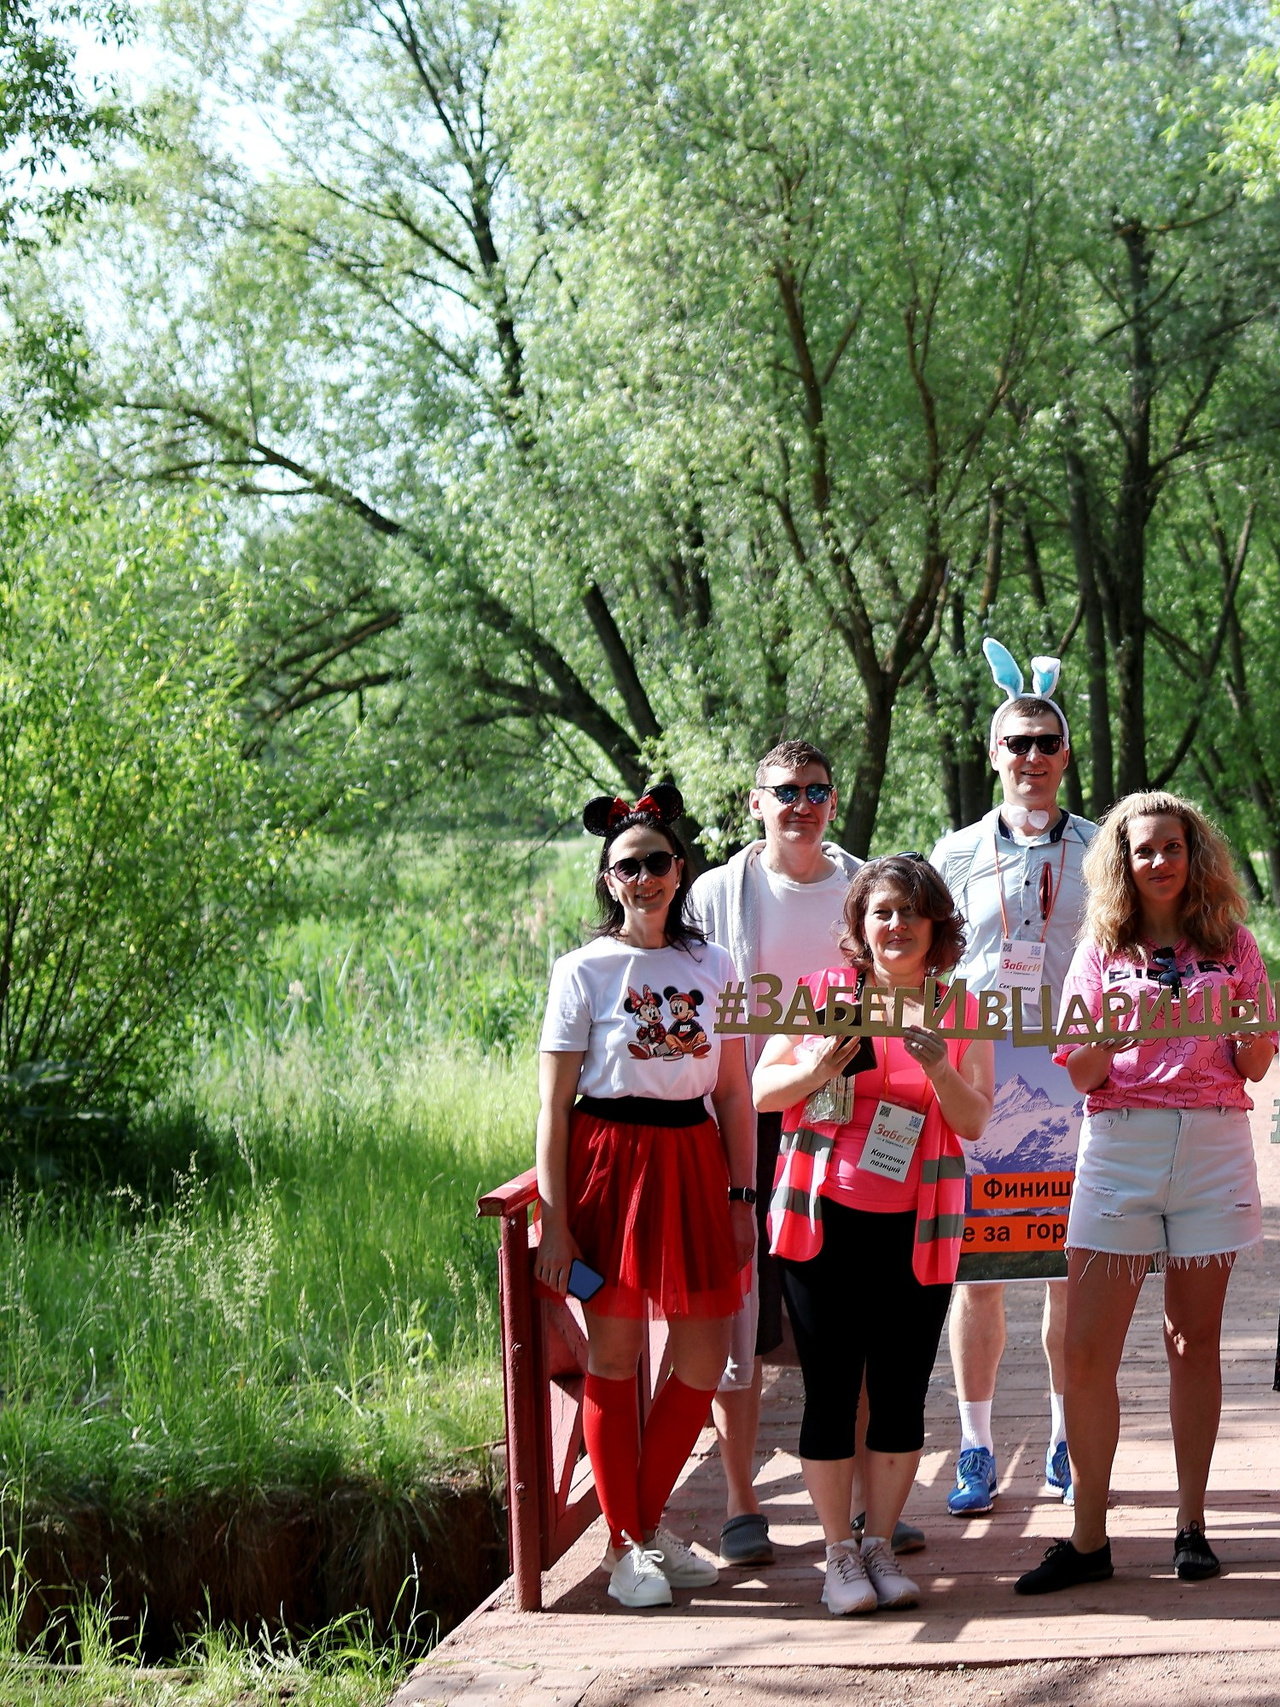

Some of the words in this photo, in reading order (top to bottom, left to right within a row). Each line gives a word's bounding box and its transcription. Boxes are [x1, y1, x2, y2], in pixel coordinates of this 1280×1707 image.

[1001, 958, 1041, 972] ЗабегИ
[998, 983, 1036, 993] Секомер
[874, 1123, 917, 1146] ЗабегИ
[870, 1148, 906, 1165] Карточки
[869, 1159, 901, 1174] позиций
[983, 1178, 1070, 1199] Финиш
[963, 1227, 976, 1243] е
[983, 1226, 1011, 1242] за
[1026, 1223, 1066, 1243] гор
